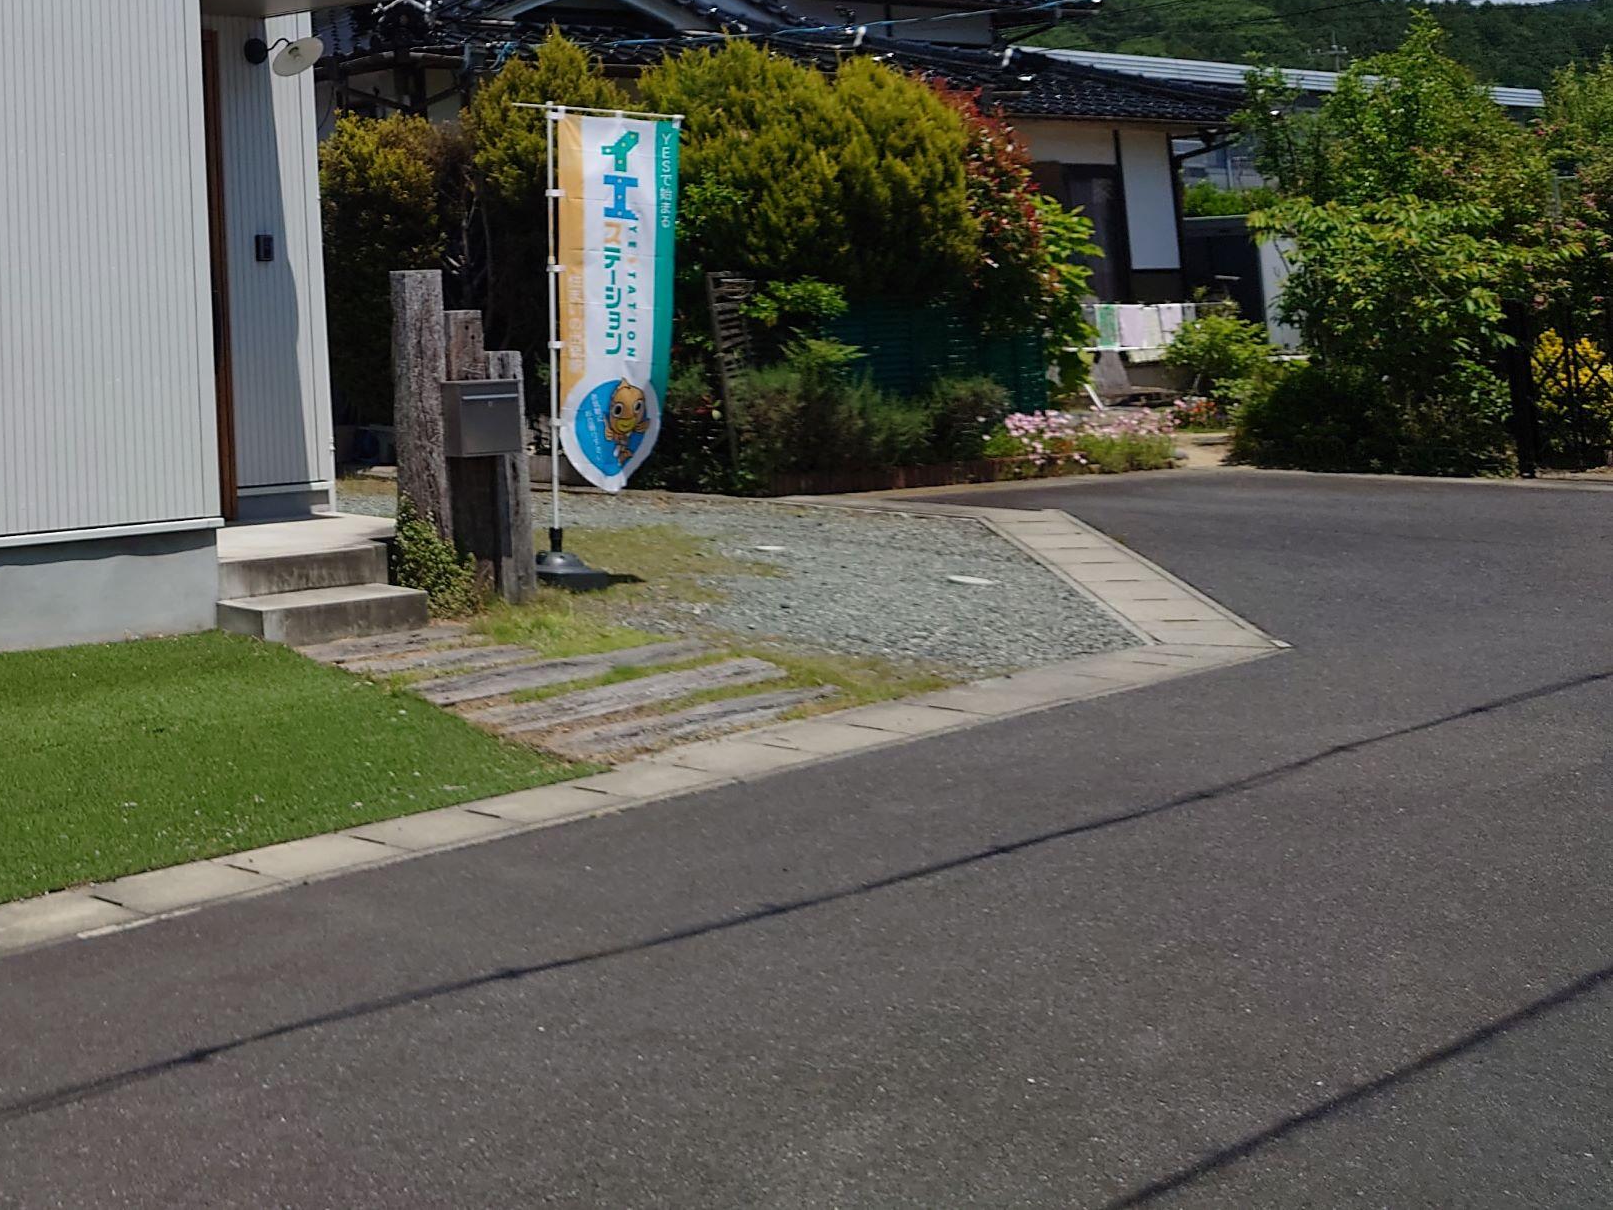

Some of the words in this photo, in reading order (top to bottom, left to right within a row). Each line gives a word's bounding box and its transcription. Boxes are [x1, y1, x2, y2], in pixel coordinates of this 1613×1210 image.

[601, 130, 640, 356] イエステーション
